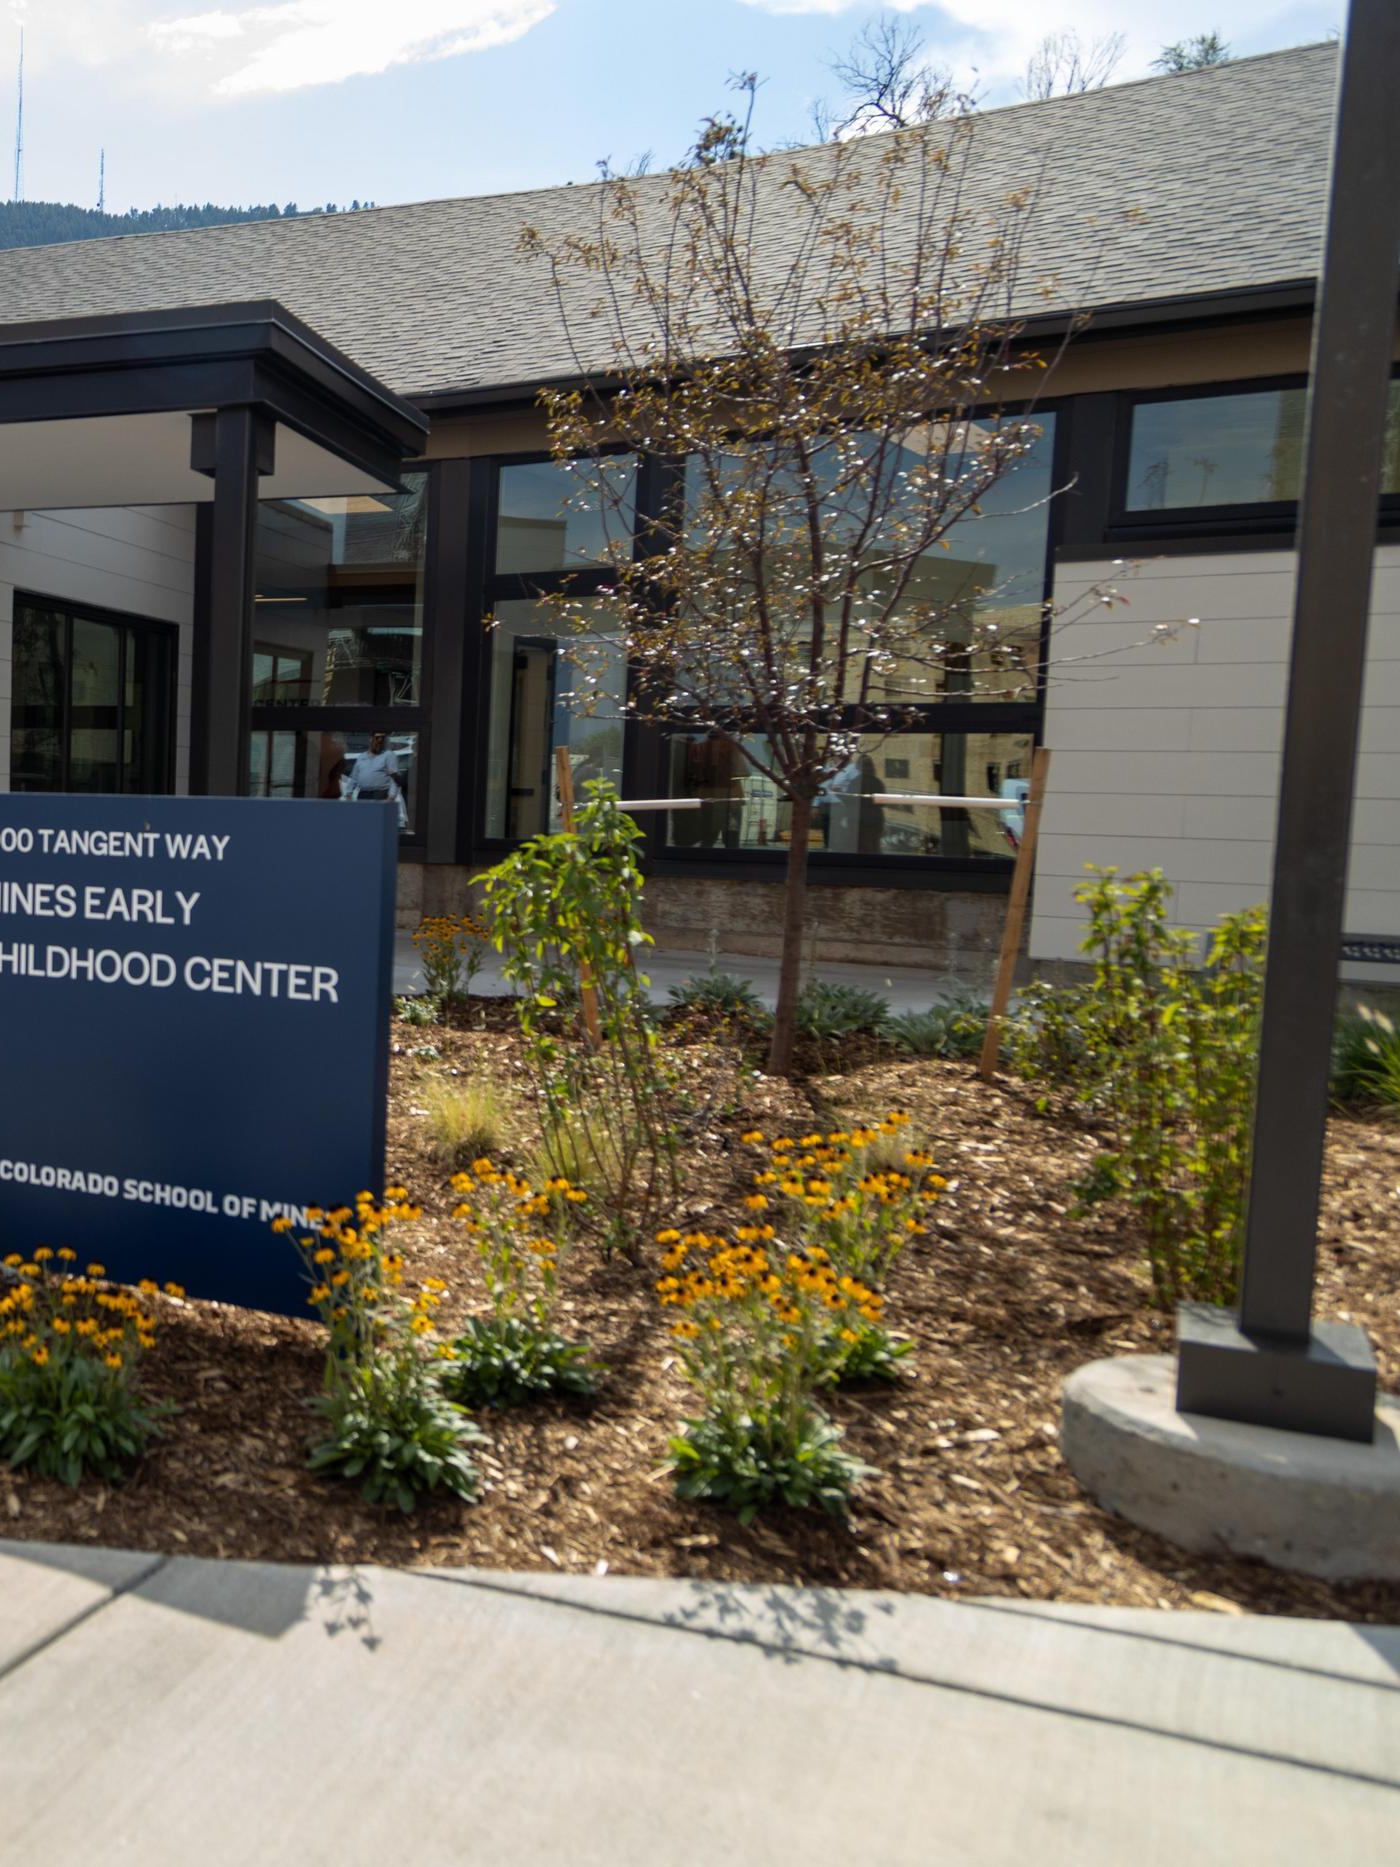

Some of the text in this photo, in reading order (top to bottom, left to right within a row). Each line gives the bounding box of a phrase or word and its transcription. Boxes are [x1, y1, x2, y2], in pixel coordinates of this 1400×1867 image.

[38, 828, 161, 858] TANGENT
[165, 832, 231, 861] WAY
[84, 885, 201, 926] EARLY
[183, 955, 339, 1003] CENTER
[123, 1178, 219, 1214] SCHOOL
[223, 1194, 258, 1219] OF
